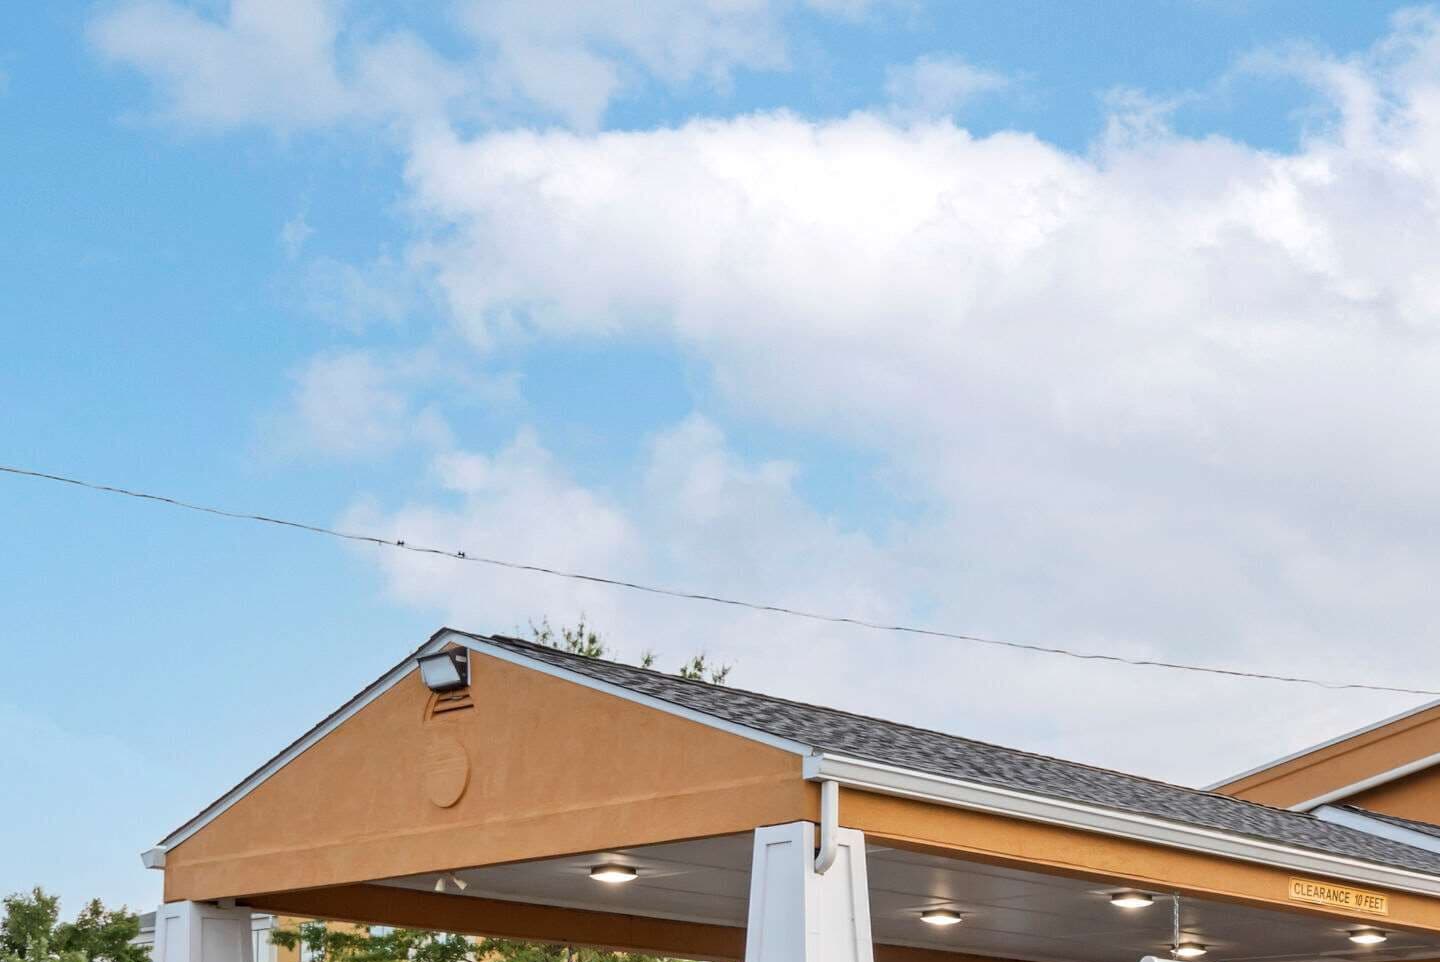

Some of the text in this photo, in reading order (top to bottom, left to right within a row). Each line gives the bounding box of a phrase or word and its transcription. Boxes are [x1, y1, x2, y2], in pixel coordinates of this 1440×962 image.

[1293, 882, 1385, 911] CLEARANCE 10 FEET
